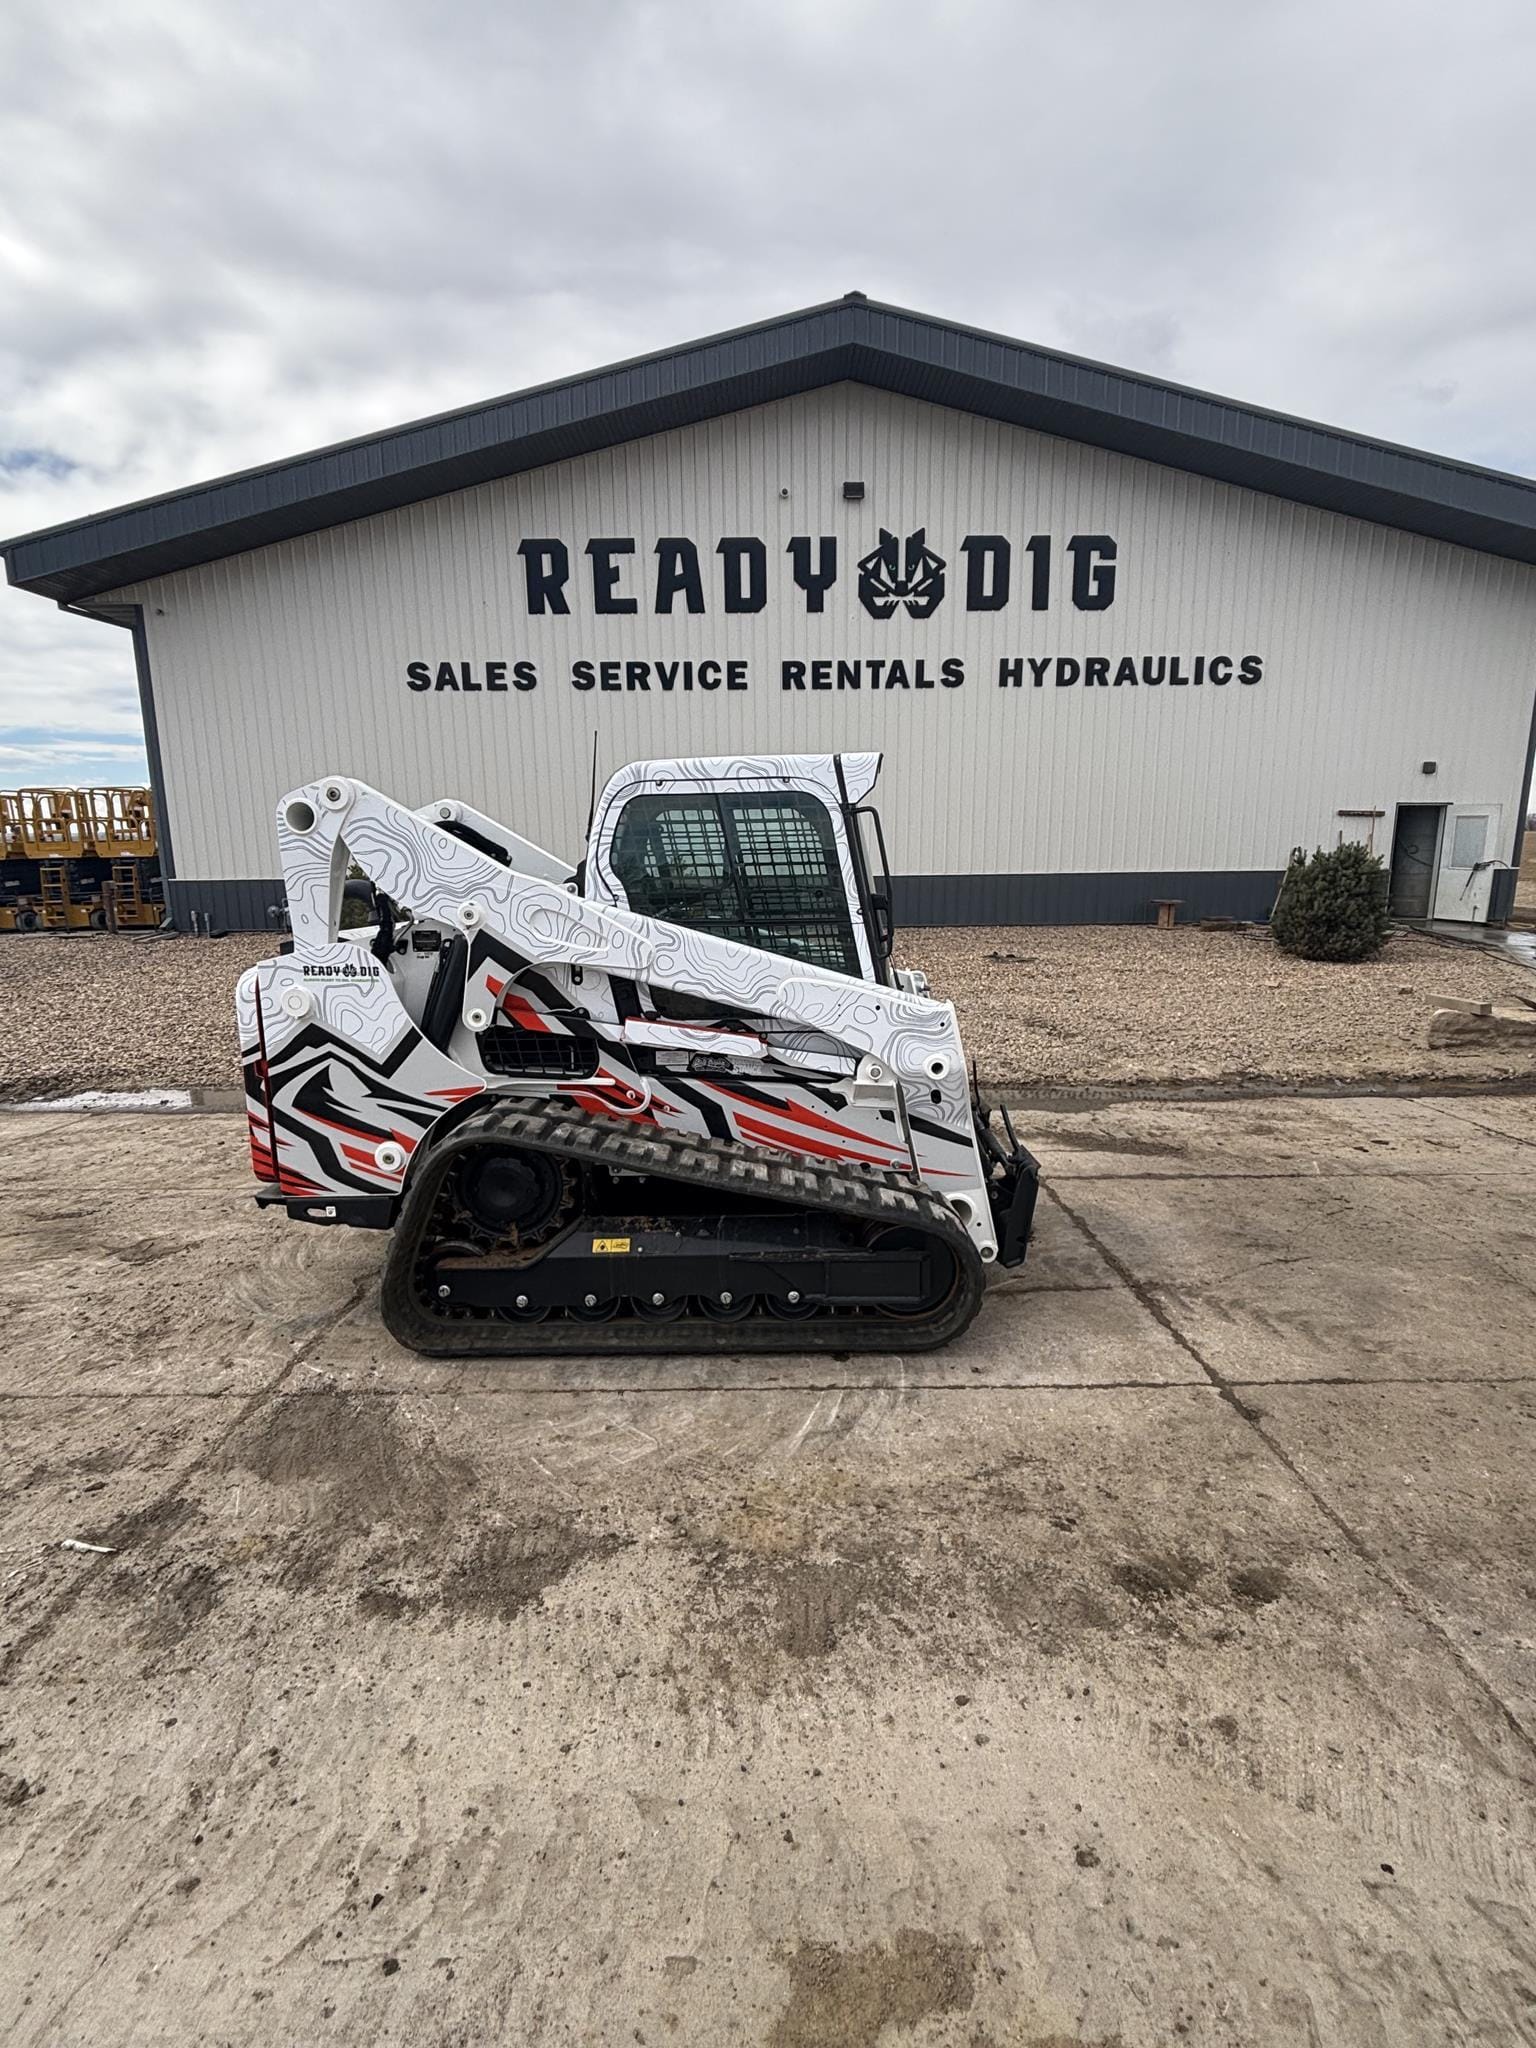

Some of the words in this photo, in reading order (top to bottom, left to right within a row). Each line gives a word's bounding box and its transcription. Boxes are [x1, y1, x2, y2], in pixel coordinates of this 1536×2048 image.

[516, 536, 838, 615] READY
[959, 535, 1118, 612] DIG
[406, 661, 537, 692] SALES
[571, 660, 748, 691] SERVICE
[781, 658, 965, 691] RENTALS
[998, 655, 1263, 688] HYDRAULICS
[303, 965, 341, 976] READY
[360, 966, 379, 977] DIG
